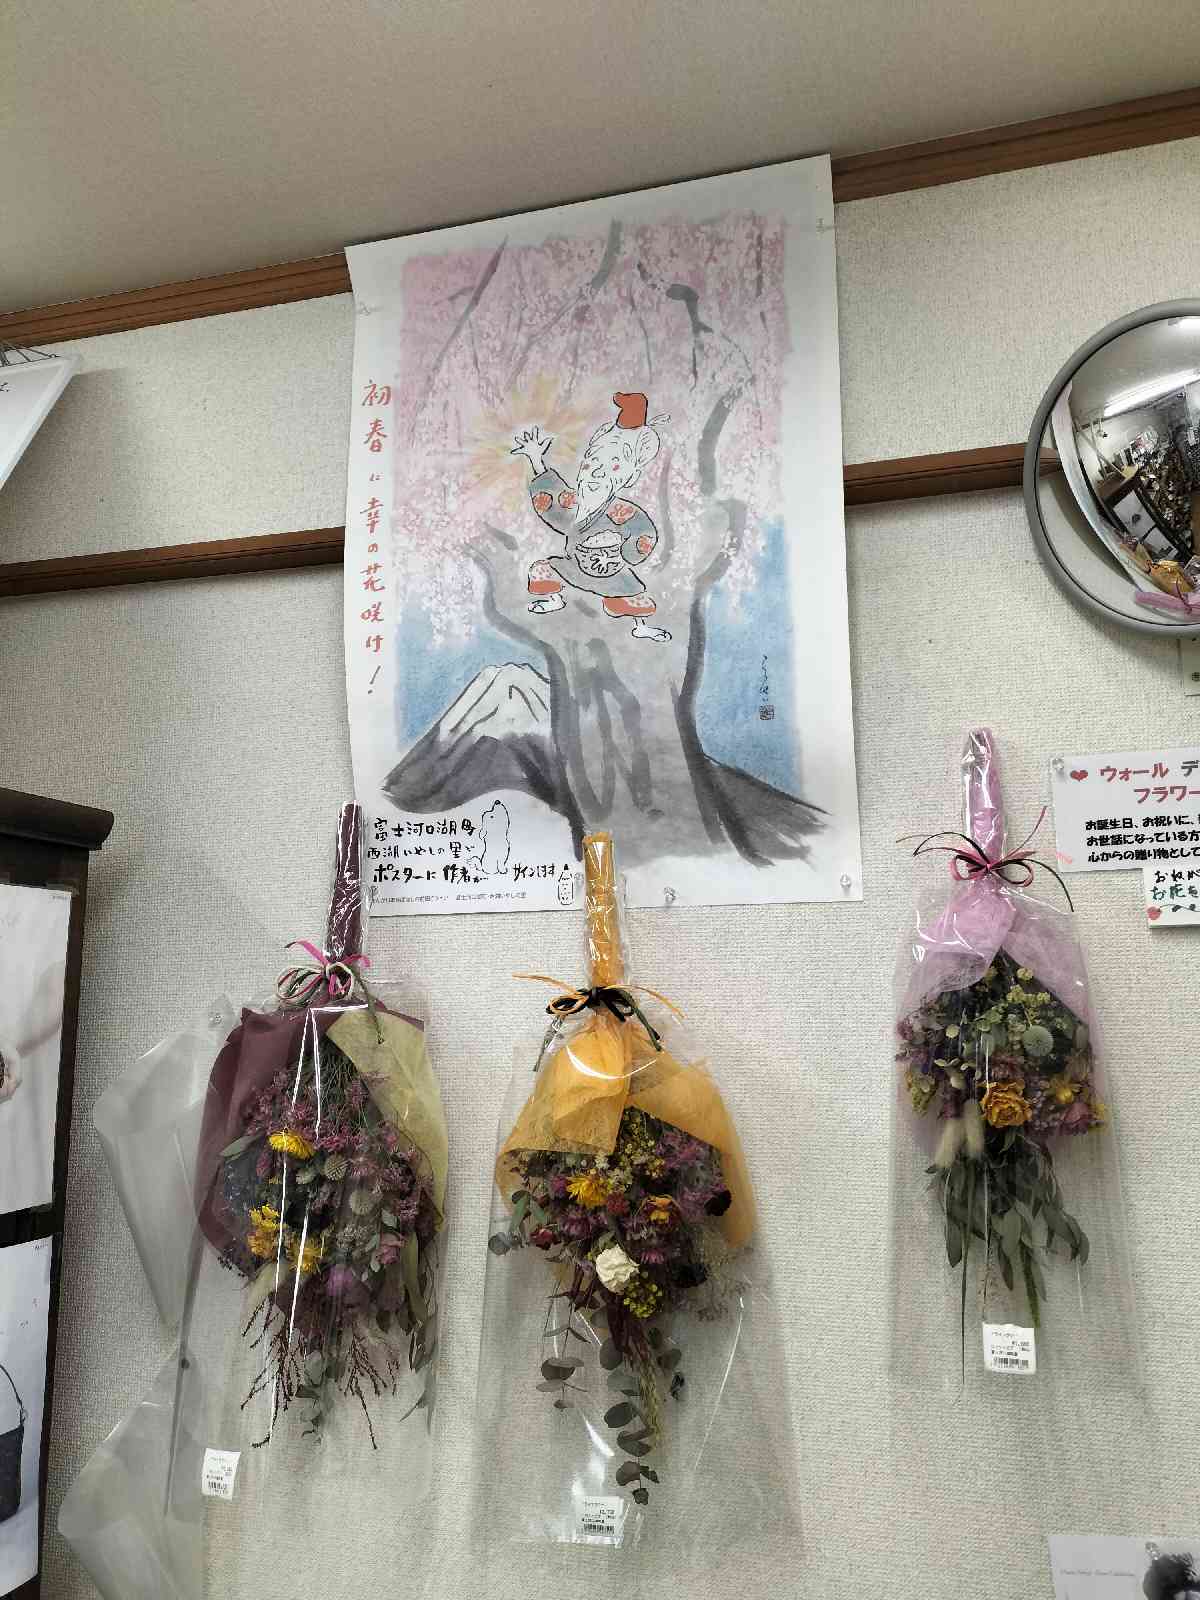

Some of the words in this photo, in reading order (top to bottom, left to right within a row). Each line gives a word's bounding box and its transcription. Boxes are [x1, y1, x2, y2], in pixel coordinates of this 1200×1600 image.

[1100, 762, 1169, 782] ウォール
[1134, 785, 1200, 803] フラワー
[1085, 815, 1200, 830] お誕生日、お祝いに、
